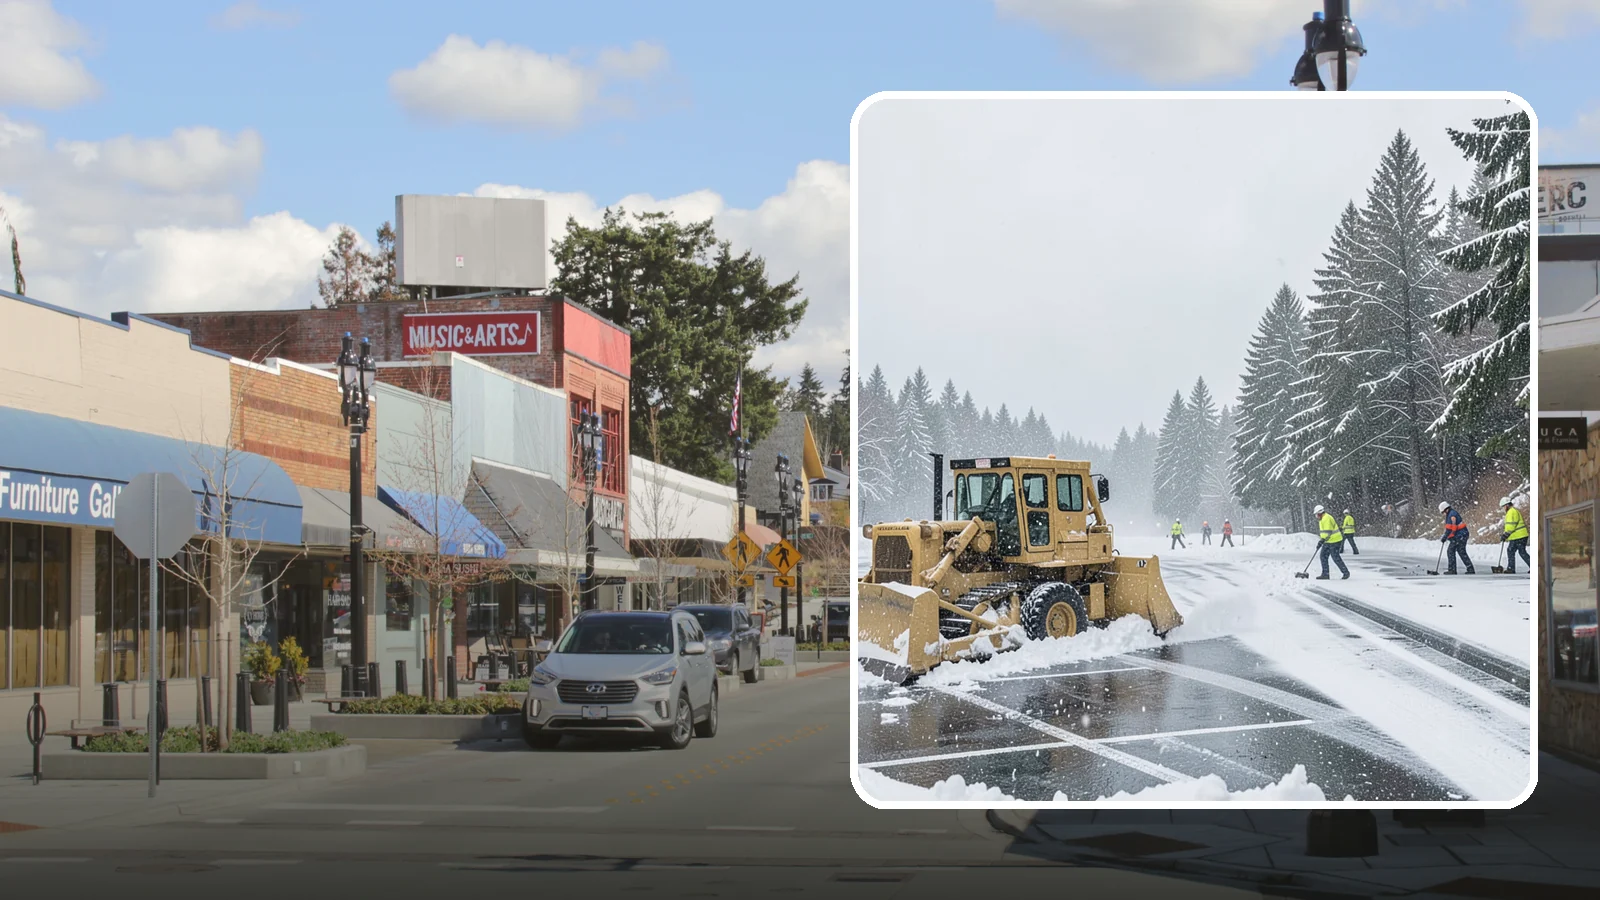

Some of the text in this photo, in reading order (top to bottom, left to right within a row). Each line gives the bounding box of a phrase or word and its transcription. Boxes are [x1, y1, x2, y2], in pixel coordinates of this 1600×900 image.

[408, 322, 520, 349] MUSIC&ARTS
[0, 471, 122, 520] Furniture Gal
